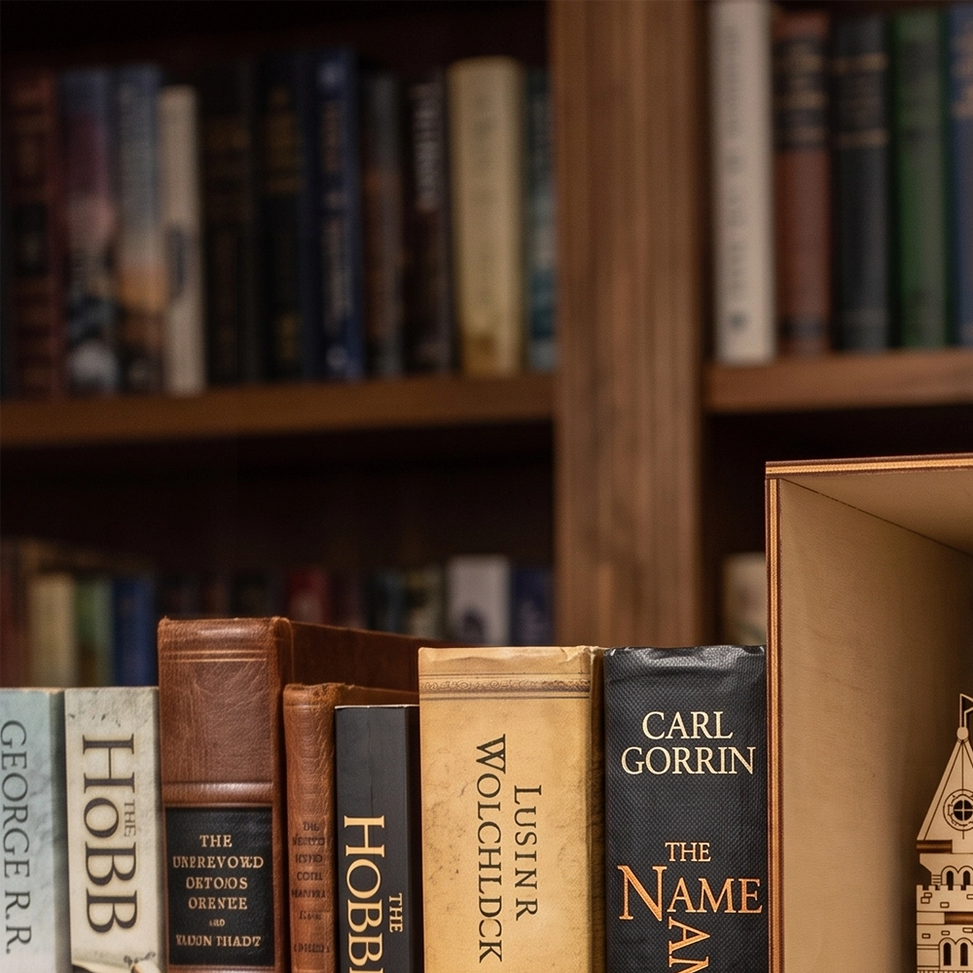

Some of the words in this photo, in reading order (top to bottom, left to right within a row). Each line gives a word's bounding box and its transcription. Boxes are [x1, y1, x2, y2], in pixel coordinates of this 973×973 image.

[642, 711, 733, 741] CARL
[620, 746, 756, 775] GORRIN
[0, 720, 31, 878] GEORGE
[123, 799, 137, 838] THE
[81, 733, 139, 934] HOBB
[199, 834, 233, 848] THE
[664, 842, 712, 862] THE
[388, 892, 403, 933] THE
[617, 865, 763, 921] NAME
